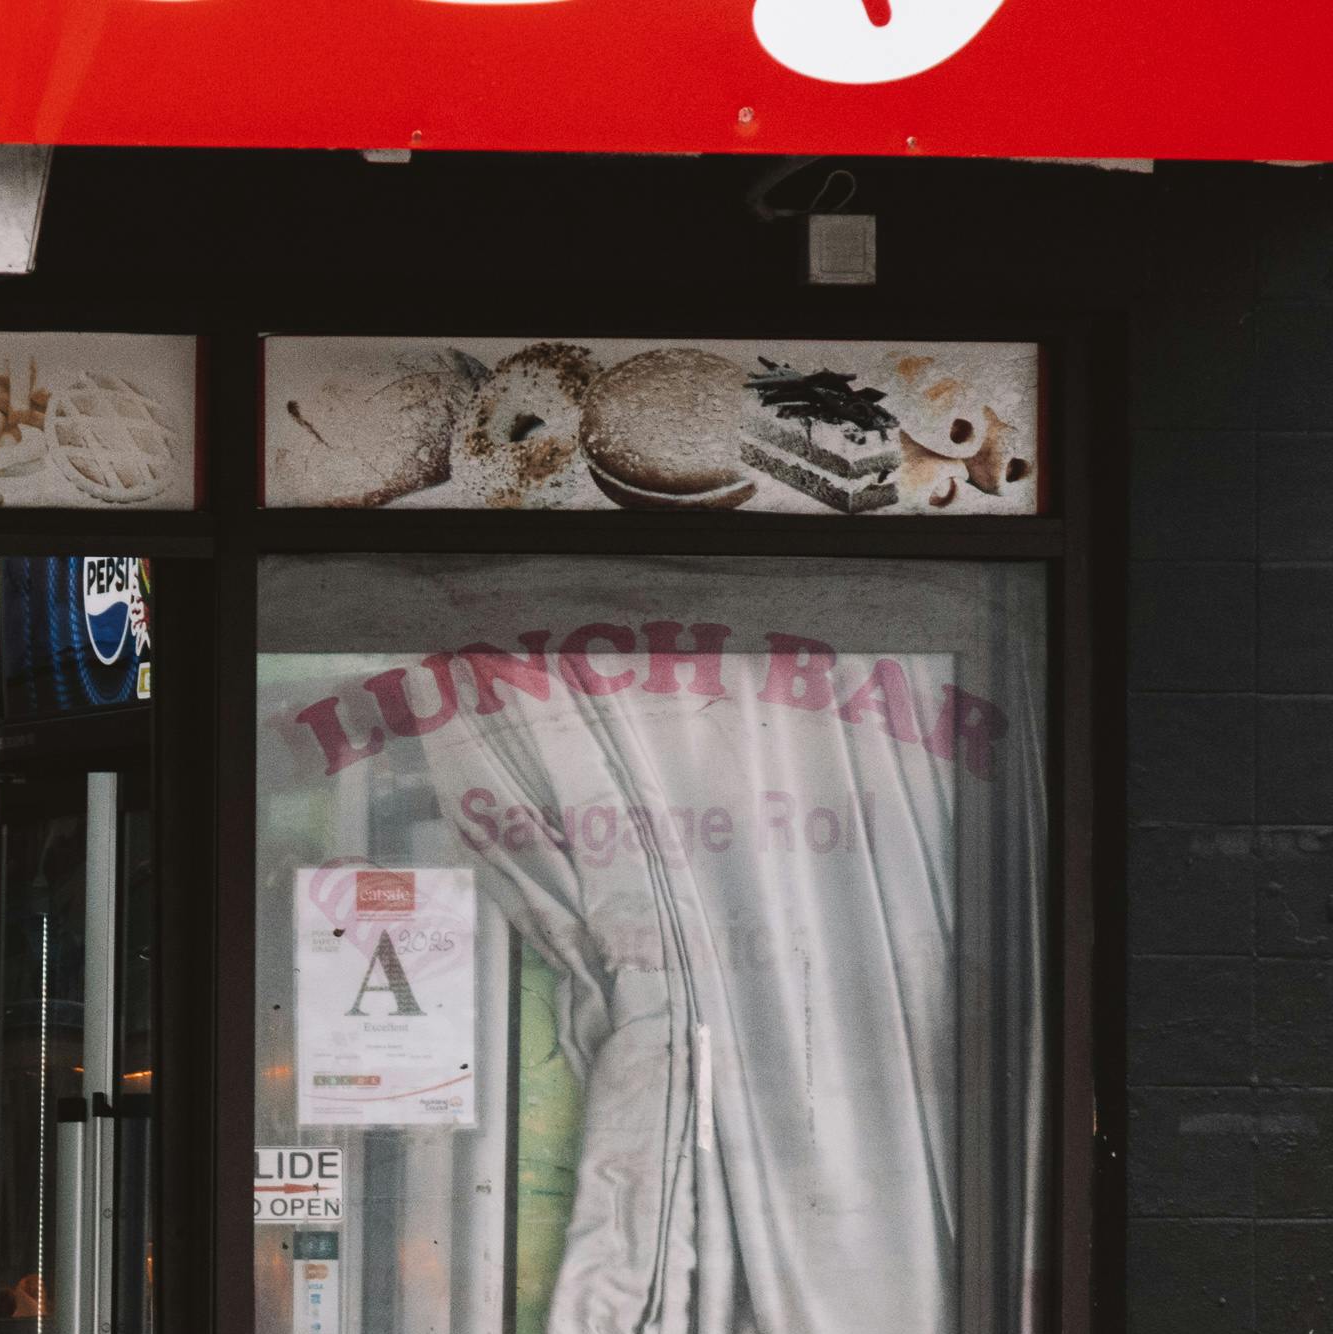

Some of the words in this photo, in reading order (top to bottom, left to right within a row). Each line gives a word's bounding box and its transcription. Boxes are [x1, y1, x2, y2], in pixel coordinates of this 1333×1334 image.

[87, 557, 129, 596] PEPSI
[295, 621, 732, 777] LUNCH
[757, 631, 1008, 782] BAR
[344, 929, 428, 1017] A
[253, 1151, 339, 1180] LIDE
[270, 1198, 340, 1217] OPEN
